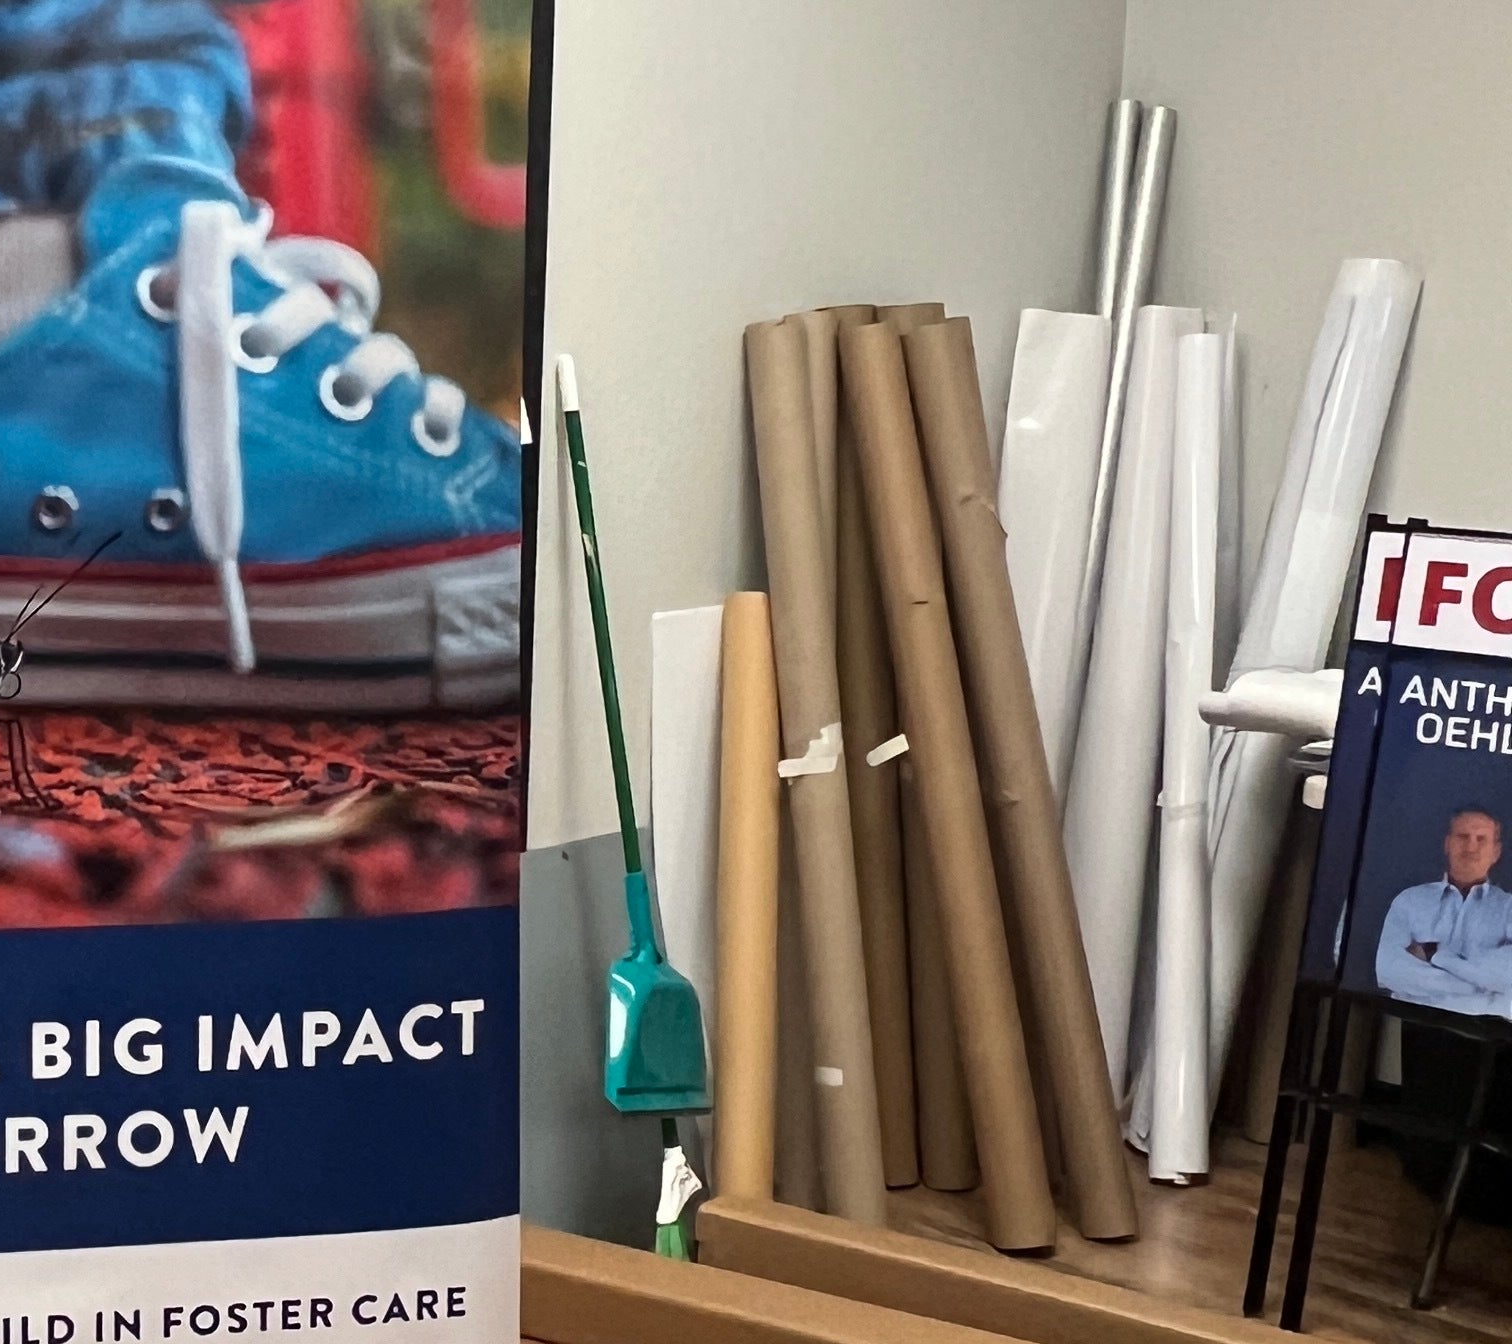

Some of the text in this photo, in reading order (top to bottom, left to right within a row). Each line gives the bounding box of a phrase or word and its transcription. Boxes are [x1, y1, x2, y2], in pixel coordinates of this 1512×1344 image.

[32, 1018, 162, 1079] BIG
[199, 999, 484, 1071] IMPACT
[96, 1310, 140, 1342] IN
[164, 1298, 333, 1338] FOSTER
[352, 1287, 466, 1325] CARE
